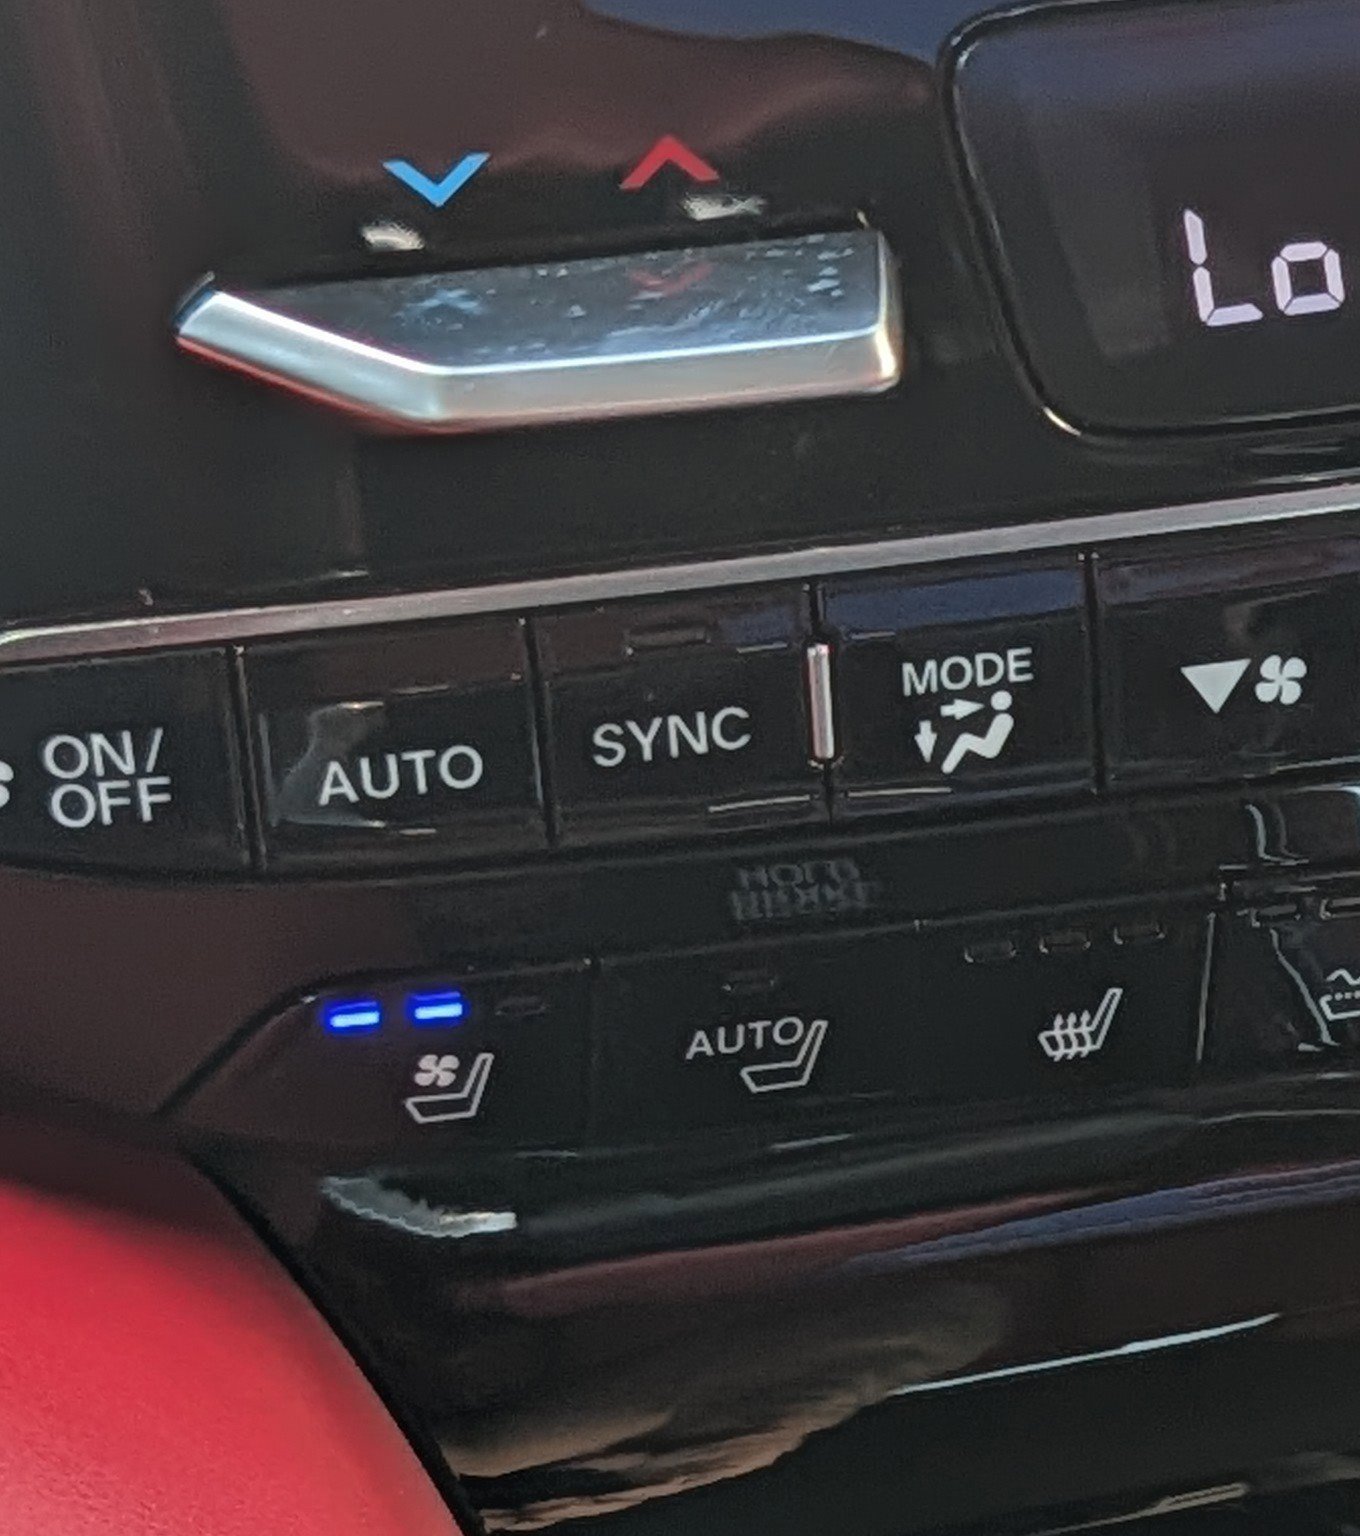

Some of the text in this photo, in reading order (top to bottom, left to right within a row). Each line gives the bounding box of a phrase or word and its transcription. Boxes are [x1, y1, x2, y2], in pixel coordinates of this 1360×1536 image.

[1183, 209, 1346, 327] Lo
[901, 646, 1034, 697] MODE
[42, 727, 164, 780] ON/
[592, 705, 752, 768] SYNC
[49, 775, 172, 829] OFF
[317, 744, 484, 807] AUTO
[684, 1015, 804, 1061] AUTO
